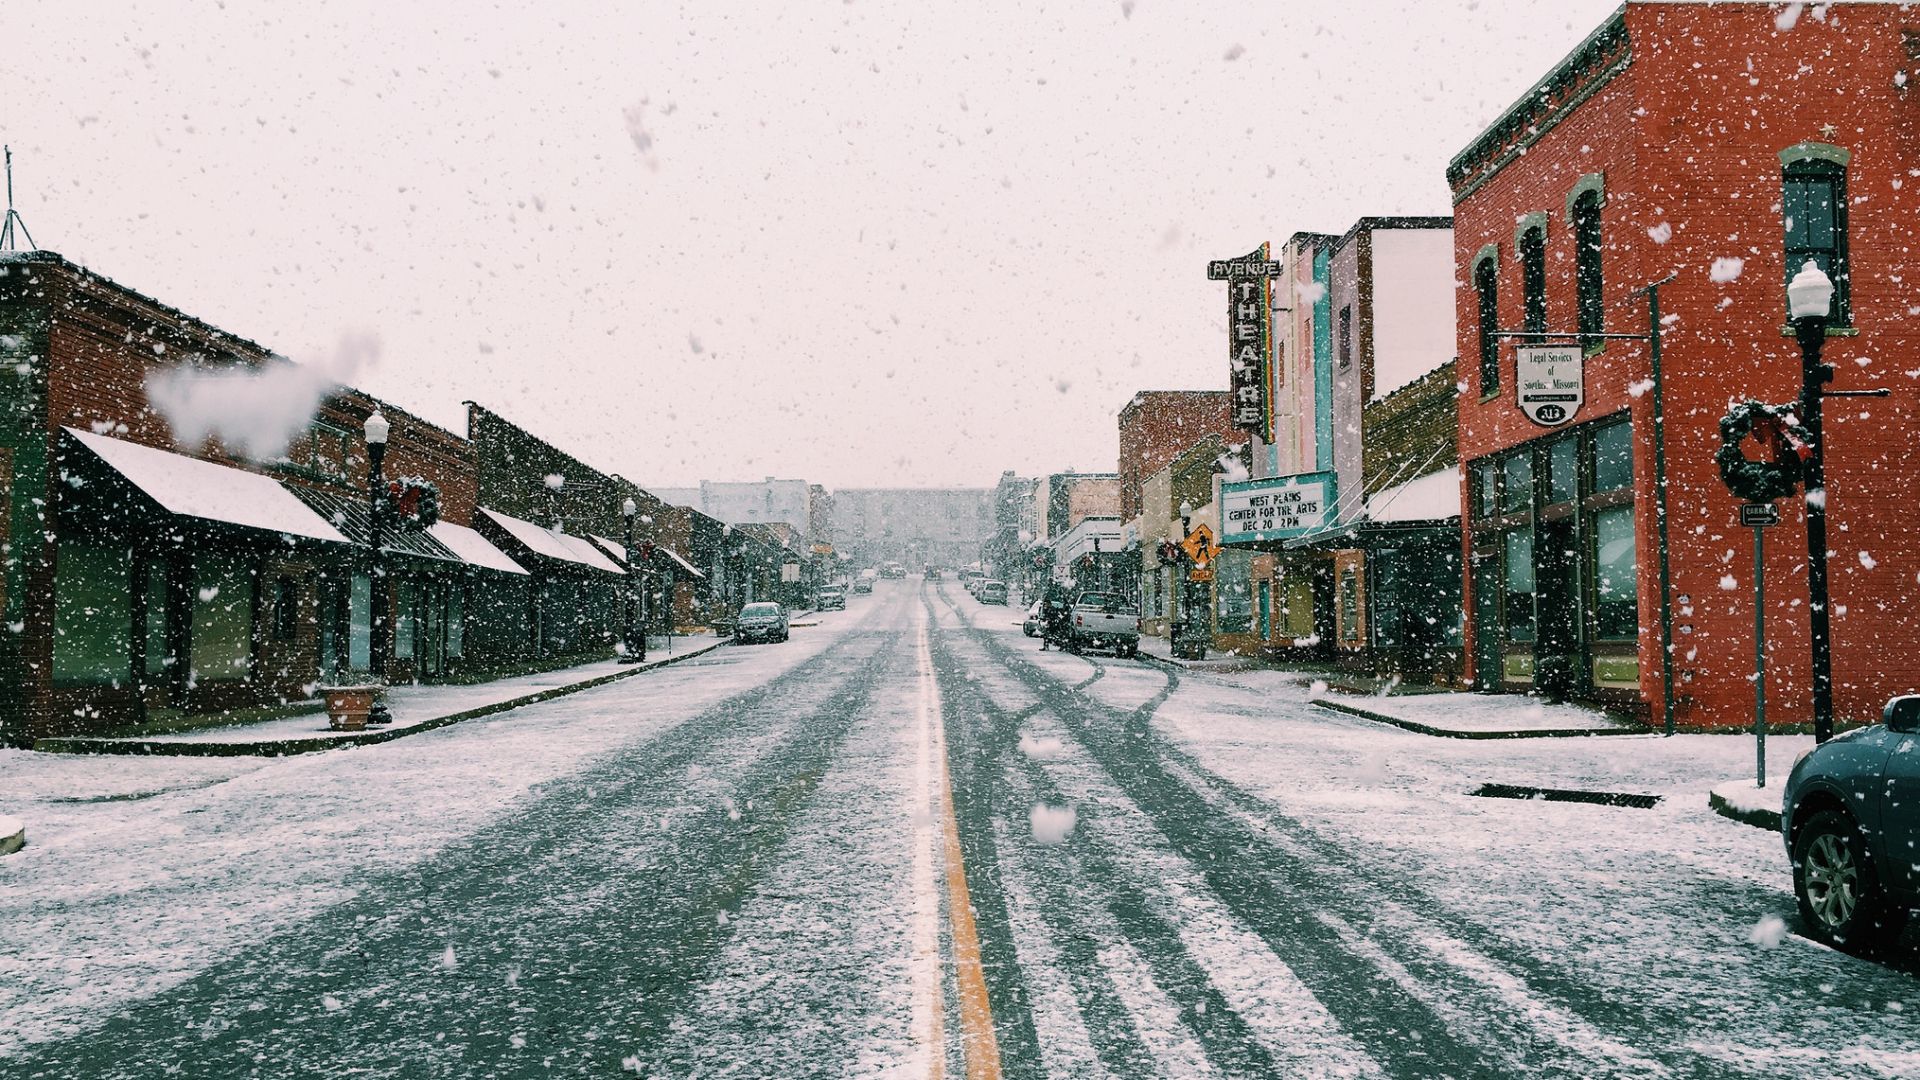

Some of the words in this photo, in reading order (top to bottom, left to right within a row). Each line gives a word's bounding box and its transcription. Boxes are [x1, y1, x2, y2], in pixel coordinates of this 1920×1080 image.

[1214, 262, 1278, 275] AVENUE
[1236, 282, 1259, 423] THEATRE
[1529, 352, 1546, 363] Legal
[1548, 366, 1554, 376] of
[1249, 495, 1270, 507] WEST
[1229, 509, 1257, 521] CENTER
[1259, 507, 1275, 518] FOR
[1277, 504, 1292, 516] THE
[1296, 502, 1317, 514] ARTS
[1243, 520, 1258, 531] DEC
[1262, 519, 1273, 530] 20
